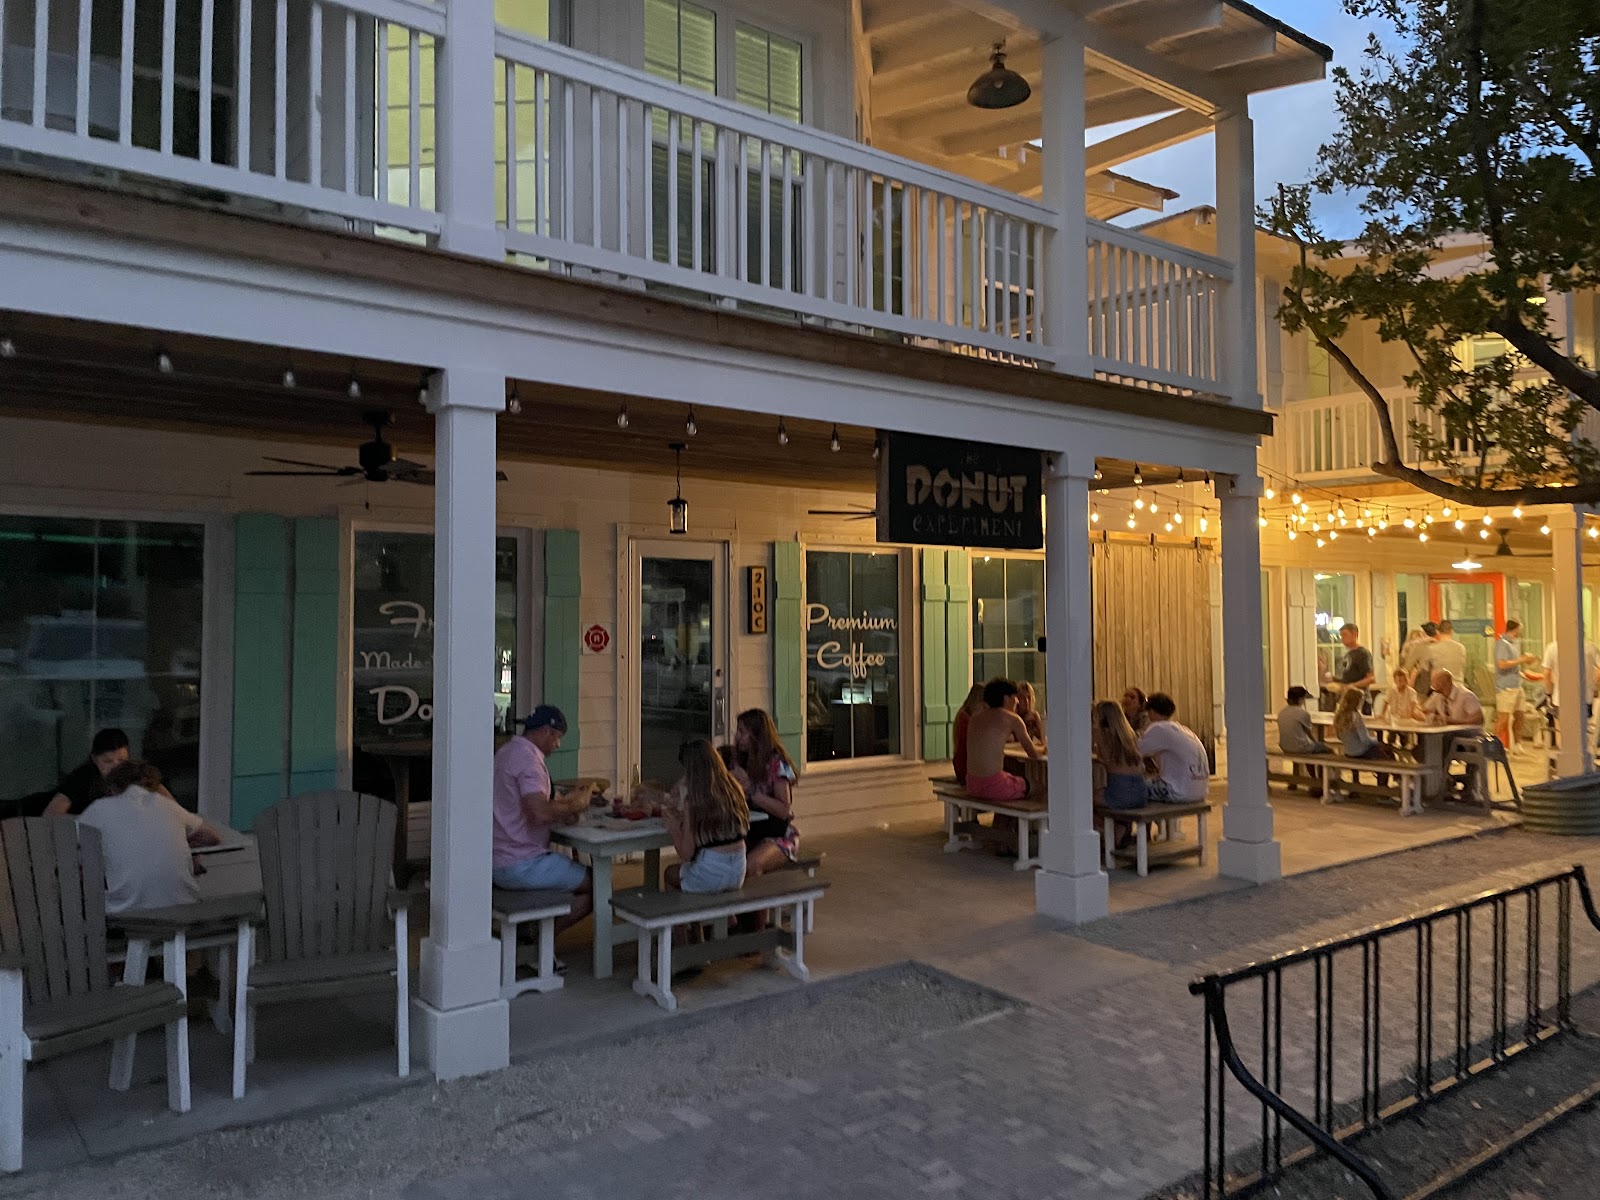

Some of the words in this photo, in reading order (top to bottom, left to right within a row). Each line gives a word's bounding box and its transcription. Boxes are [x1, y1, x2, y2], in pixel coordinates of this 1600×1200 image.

[905, 463, 1028, 513] DONUT
[806, 602, 897, 632] Premium
[360, 650, 422, 670] Made
[816, 640, 886, 679] Coffee
